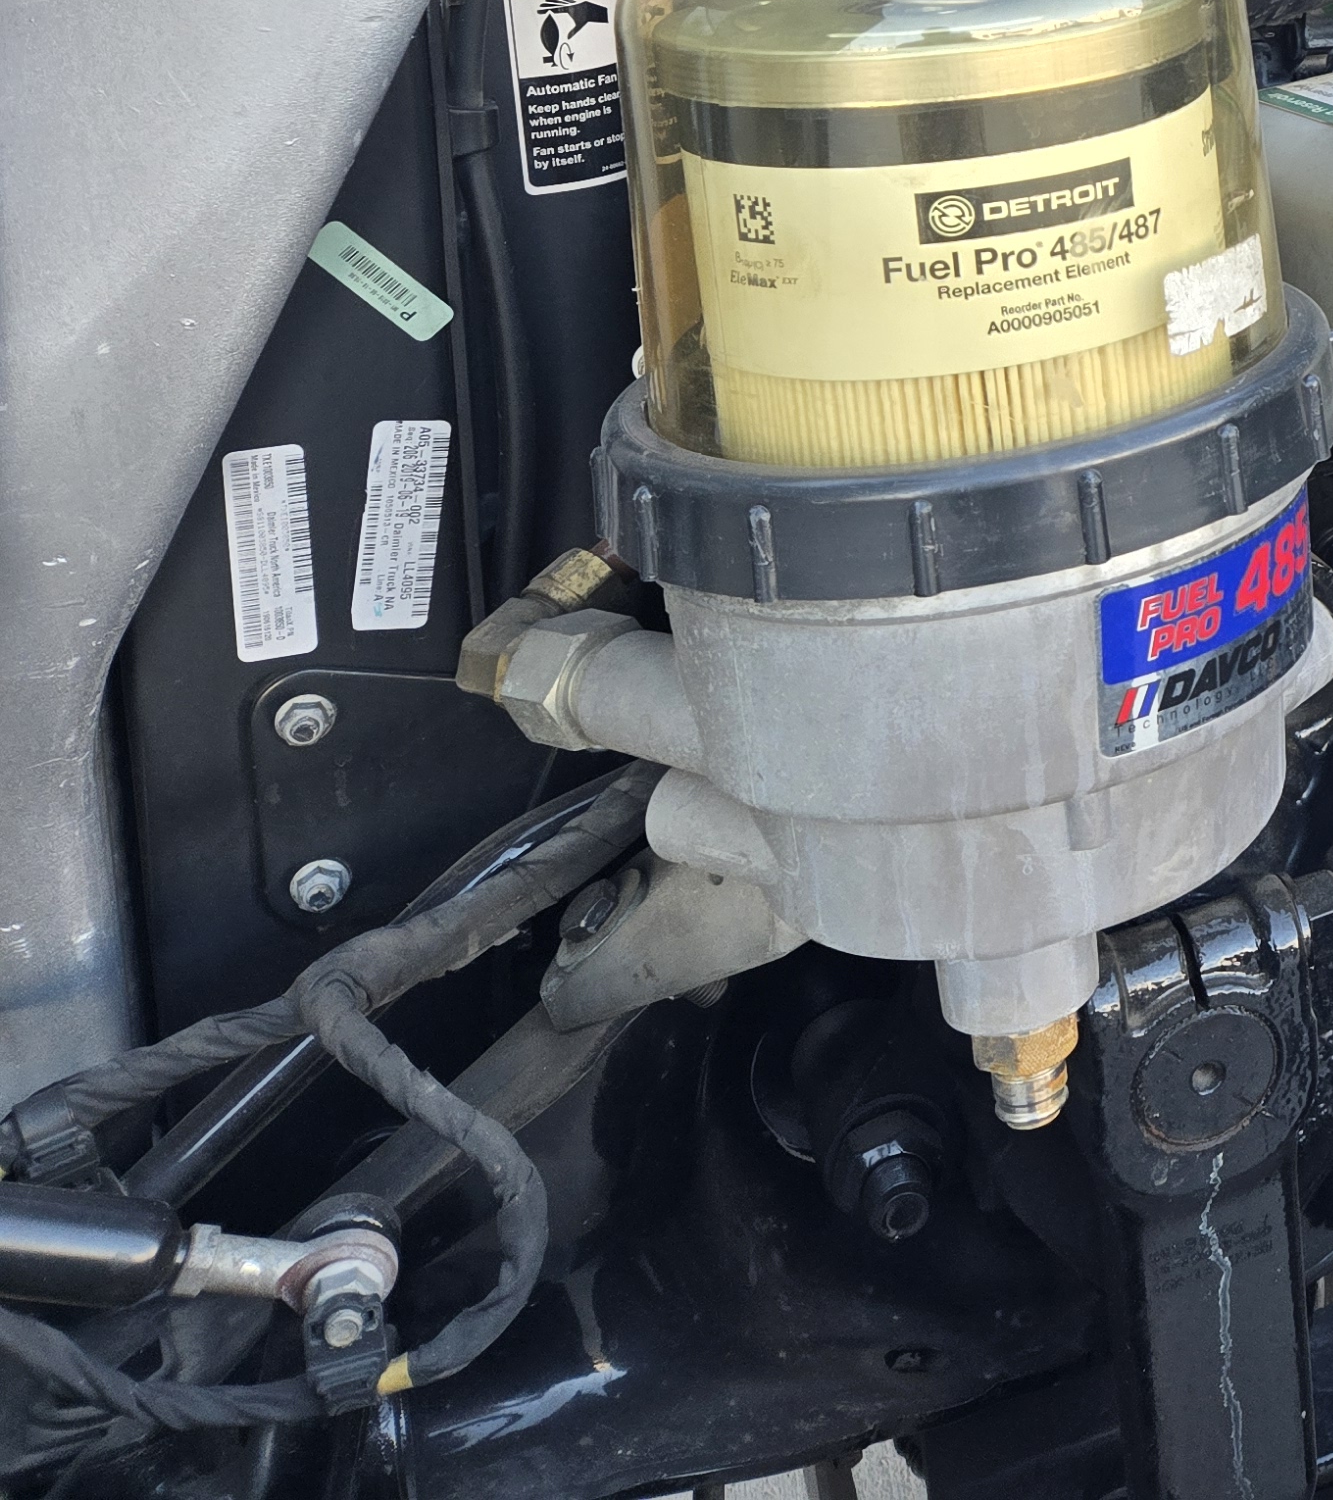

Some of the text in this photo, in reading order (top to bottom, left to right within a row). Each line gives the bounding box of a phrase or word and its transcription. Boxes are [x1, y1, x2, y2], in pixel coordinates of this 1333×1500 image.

[526, 73, 618, 97] Automatic Fan
[528, 91, 621, 115] Keep hands clear
[529, 105, 612, 127] when engine is
[531, 126, 581, 140] running.
[533, 147, 555, 157] Fan
[558, 140, 592, 154] starts
[594, 137, 605, 147] or
[534, 153, 585, 171] by itself.
[981, 176, 1121, 222] DETROIT
[881, 207, 1163, 284] Fuel Pro 485/487
[937, 251, 1132, 301] Replacement Element
[399, 311, 418, 321] P
[987, 300, 1101, 336] A0000905051
[1000, 293, 1084, 317] Reorder Part No.
[393, 420, 403, 444] MADE
[391, 446, 400, 456] IN
[250, 455, 260, 503] Made in Mexico
[387, 458, 398, 489] MEXICO
[266, 511, 277, 537] Daimler
[400, 426, 432, 600] A05-33734-002 LL4095
[269, 537, 279, 555] Truck
[391, 522, 405, 562] Daimler
[270, 555, 281, 572] North
[1136, 508, 1308, 631] FUEL 485
[272, 572, 282, 598] America
[386, 565, 399, 598] Truck
[384, 596, 395, 611] NA
[1147, 605, 1223, 662] PRO
[1157, 624, 1282, 713] DAVCO
